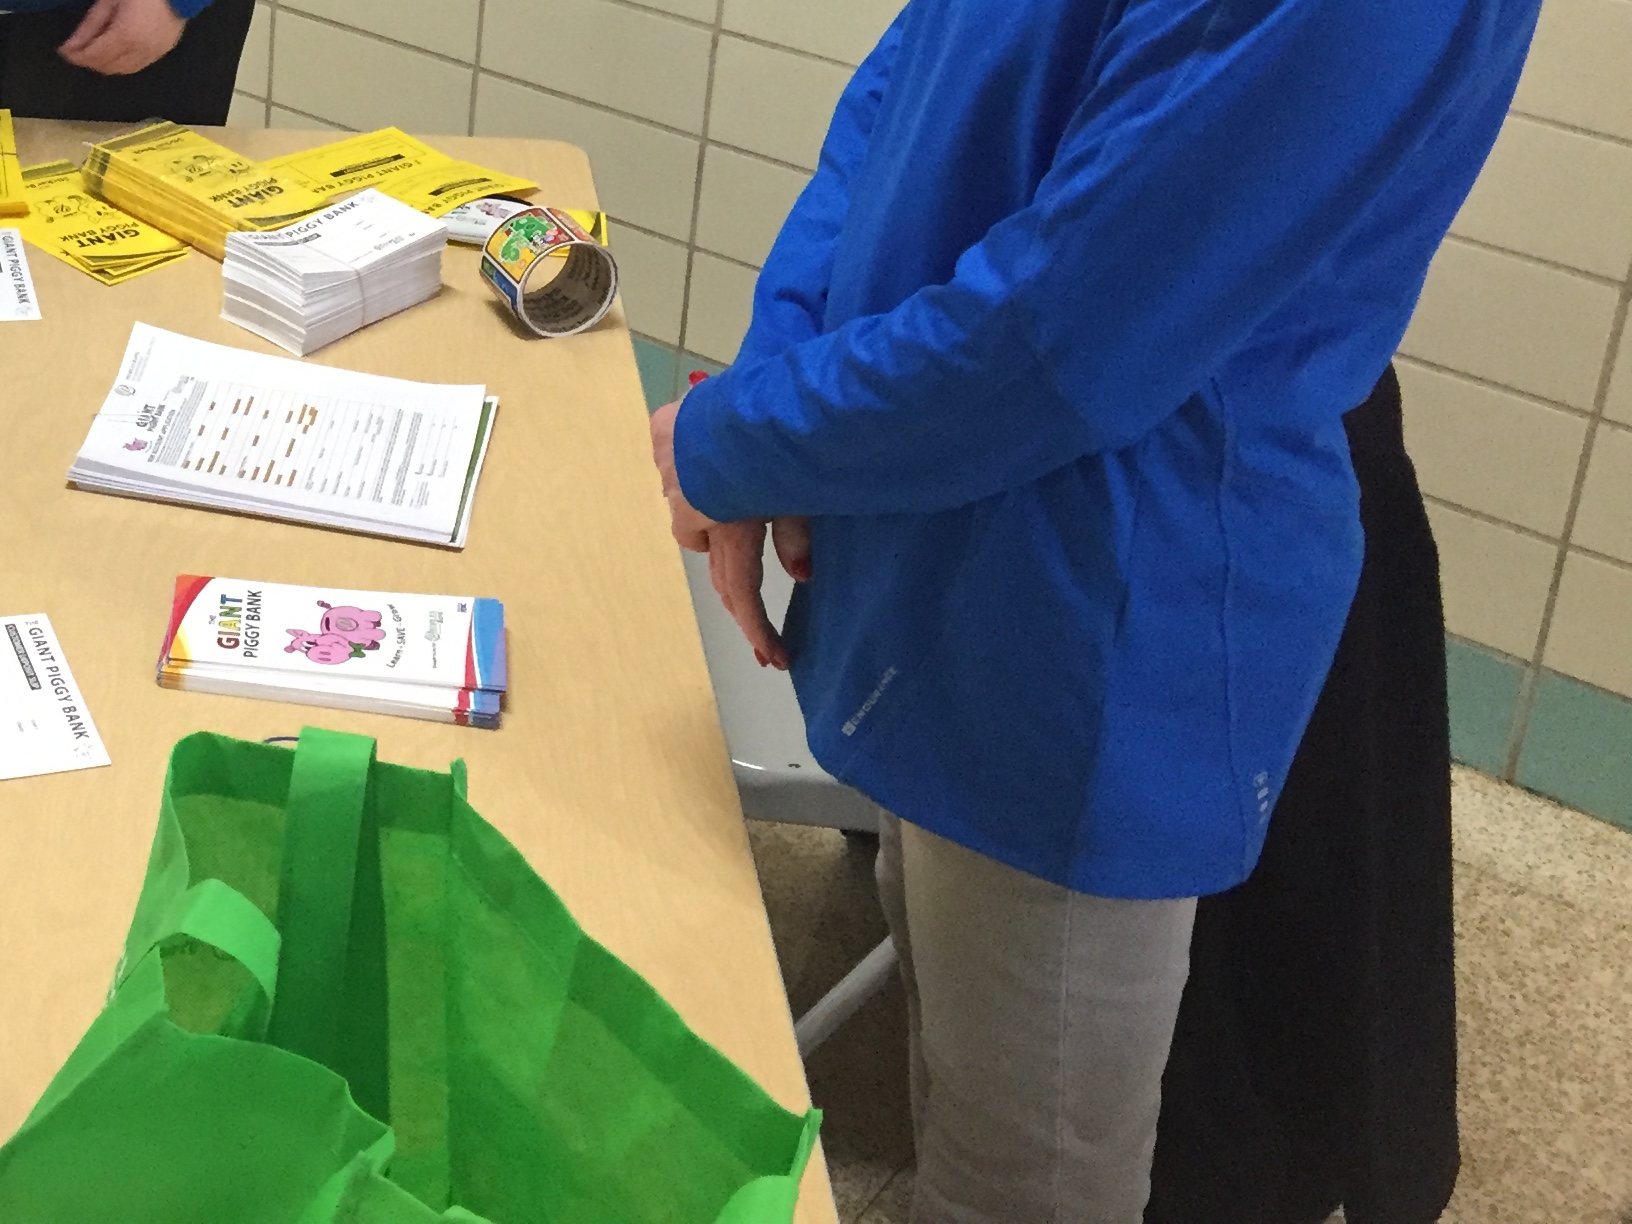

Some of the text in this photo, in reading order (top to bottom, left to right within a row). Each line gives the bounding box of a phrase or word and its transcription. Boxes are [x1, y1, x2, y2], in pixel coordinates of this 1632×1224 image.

[78, 229, 140, 248] GIANT
[285, 216, 324, 239] PIGGY
[324, 199, 358, 223] BANK
[1, 235, 31, 304] GIANT PIGGY BANK
[217, 593, 243, 650] GIANT
[243, 590, 262, 659] PIGGY BANK
[386, 602, 402, 623] Grow
[397, 626, 406, 646] SAVE
[386, 649, 402, 669] Learn
[28, 627, 90, 740] GIANT PIGGY BANK
